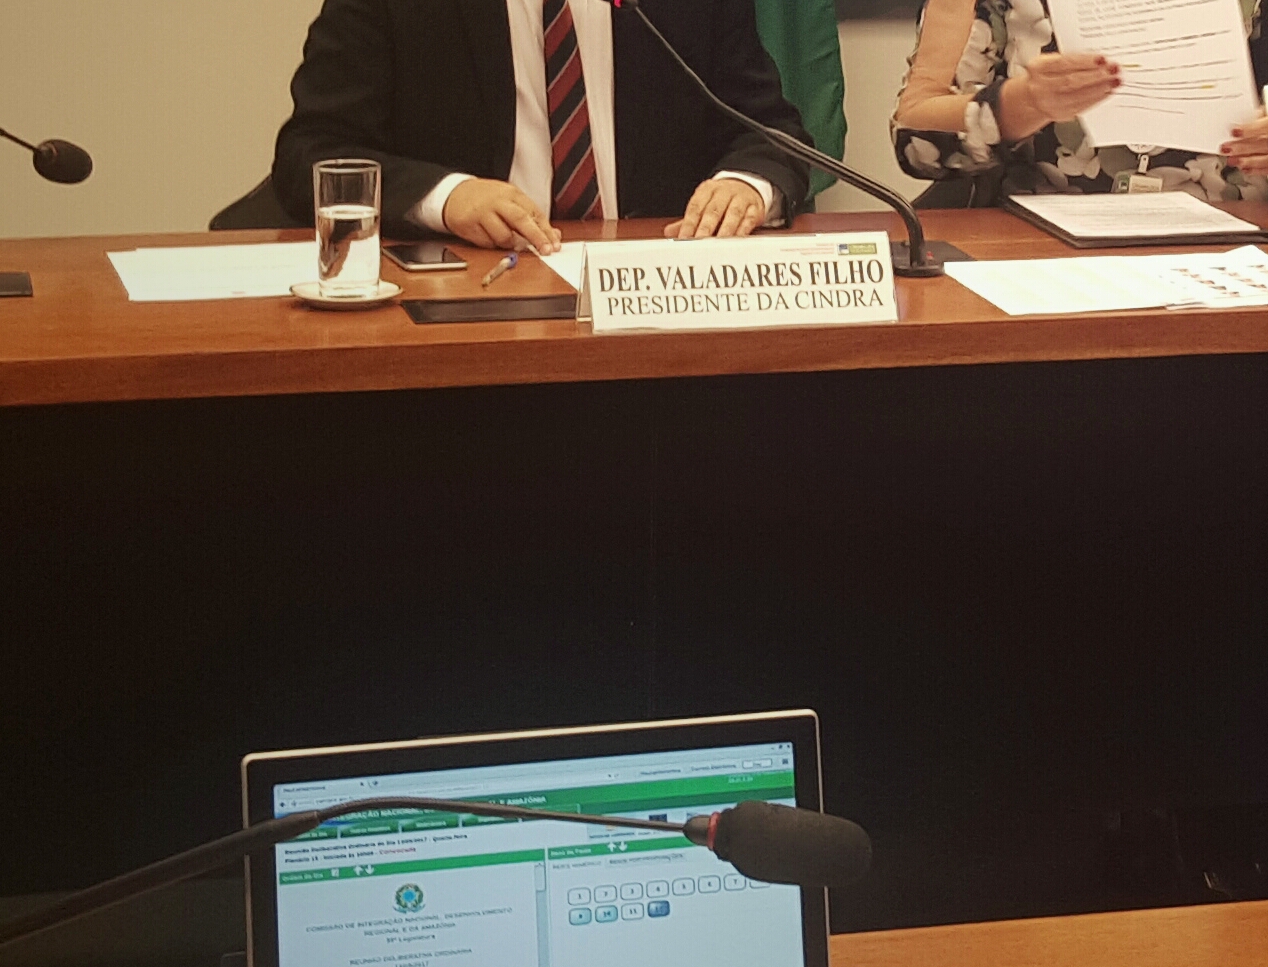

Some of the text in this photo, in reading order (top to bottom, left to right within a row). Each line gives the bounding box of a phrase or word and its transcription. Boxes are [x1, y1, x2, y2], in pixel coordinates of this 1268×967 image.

[599, 259, 884, 292] DEP. VALADARES FILHO
[607, 288, 883, 316] PRESIDENTE DA CINDRA
